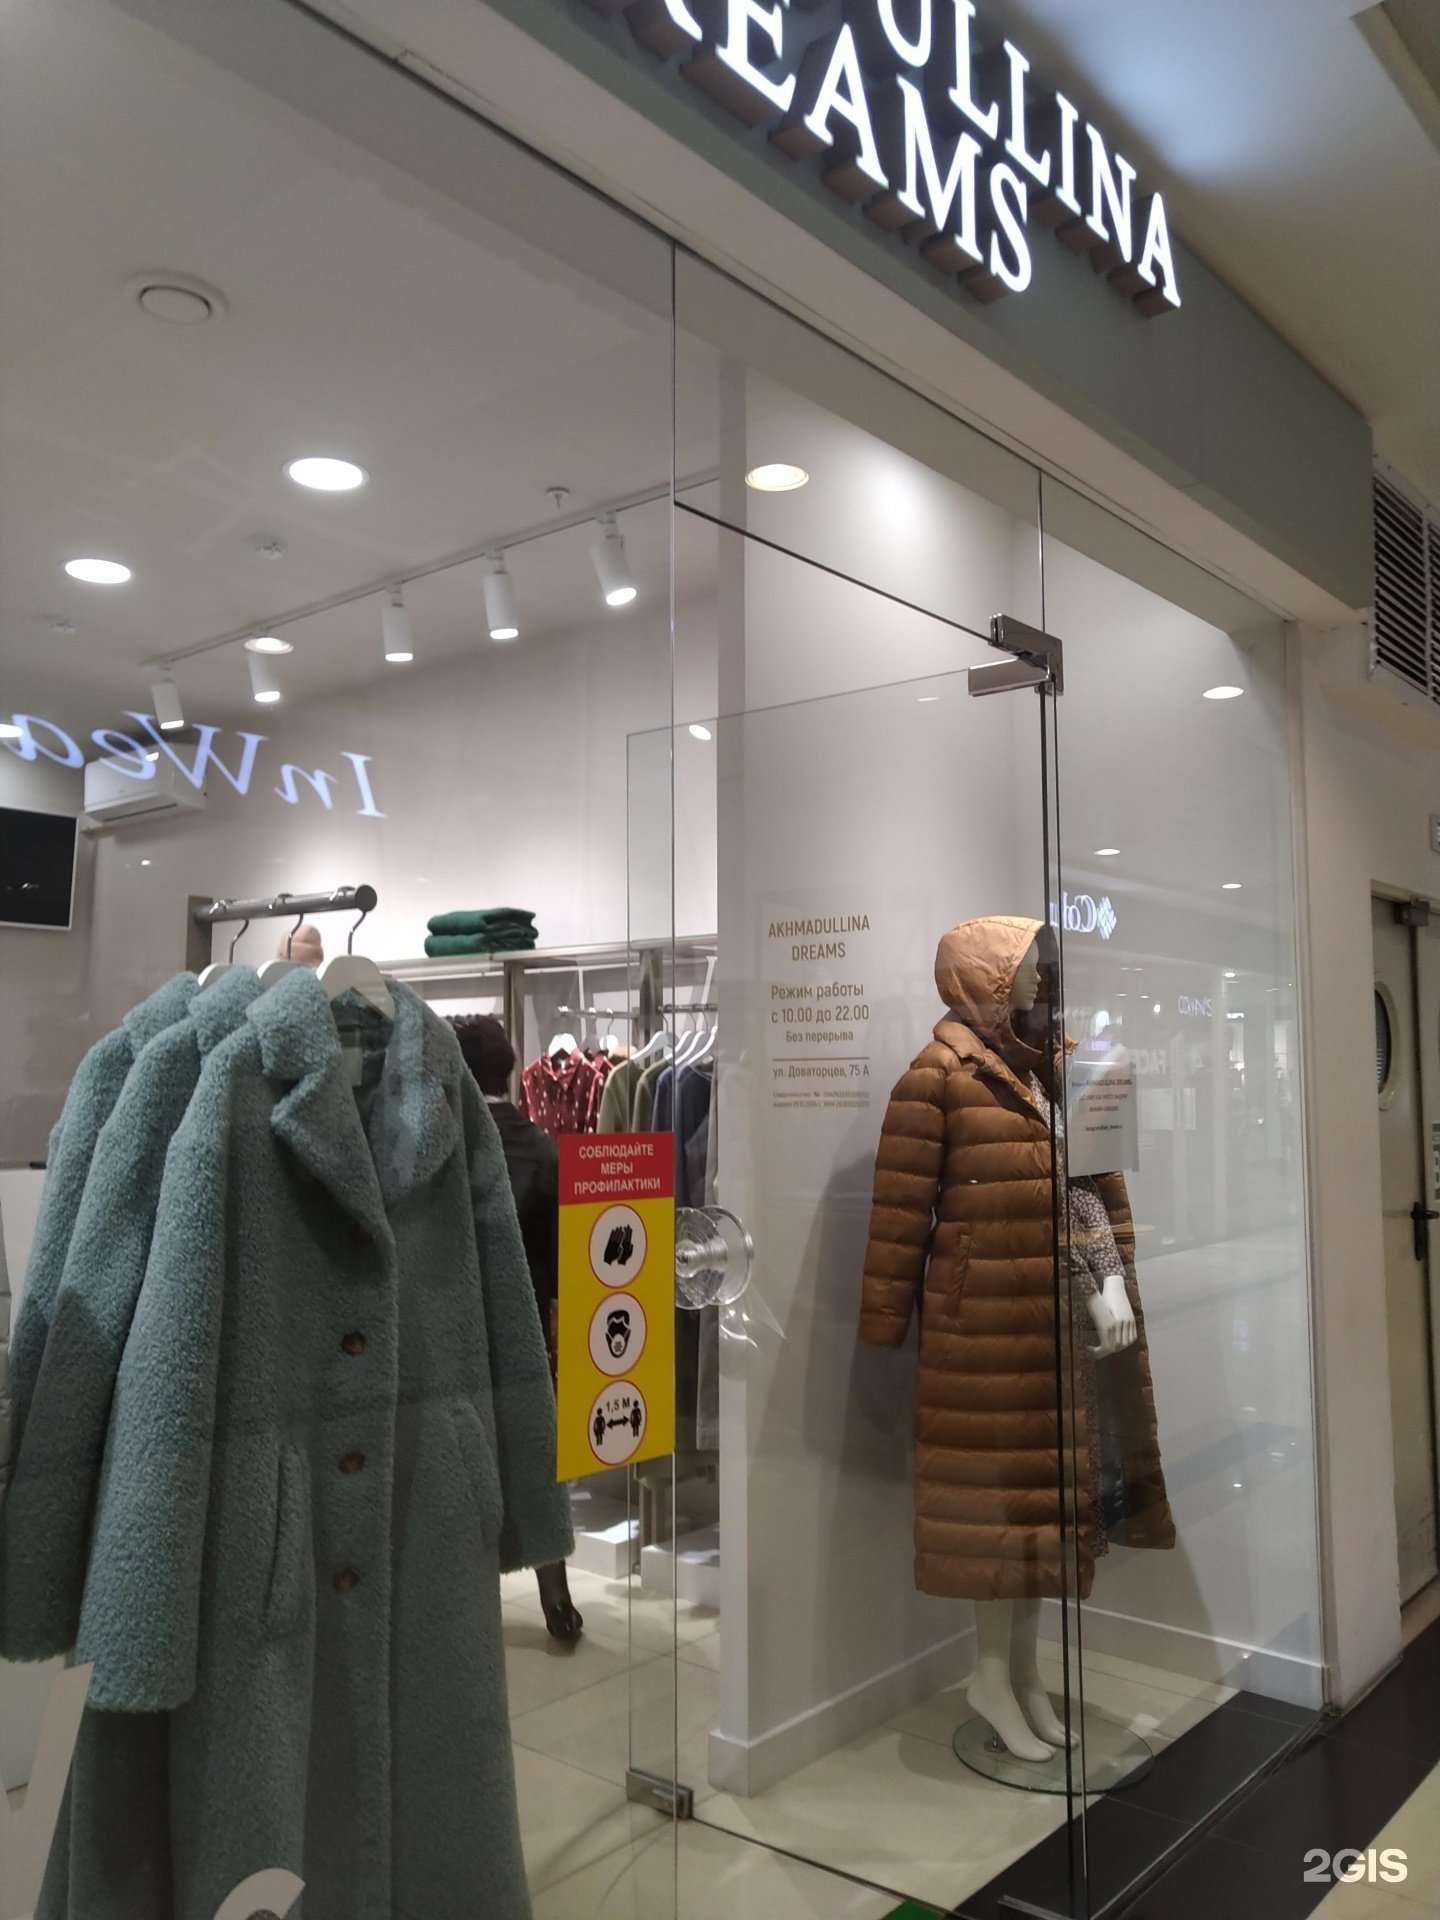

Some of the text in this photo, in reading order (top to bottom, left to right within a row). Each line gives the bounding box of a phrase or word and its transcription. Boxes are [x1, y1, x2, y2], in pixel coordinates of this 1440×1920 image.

[663, 0, 1032, 292] EAMS
[768, 915, 870, 938] AKHMADULLINA
[791, 942, 846, 962] DREAMS
[771, 981, 864, 1001] Режим работы
[771, 1005, 870, 1024] с 10.00 до 22.00
[785, 1030, 854, 1044] Без перерыва
[849, 1064, 861, 1077] 75
[578, 1142, 654, 1160] СОБЛЮДАЙТЕ
[600, 1162, 633, 1175] МЕРЫ
[574, 1177, 661, 1195] ПРОФИЛАКТИКИ
